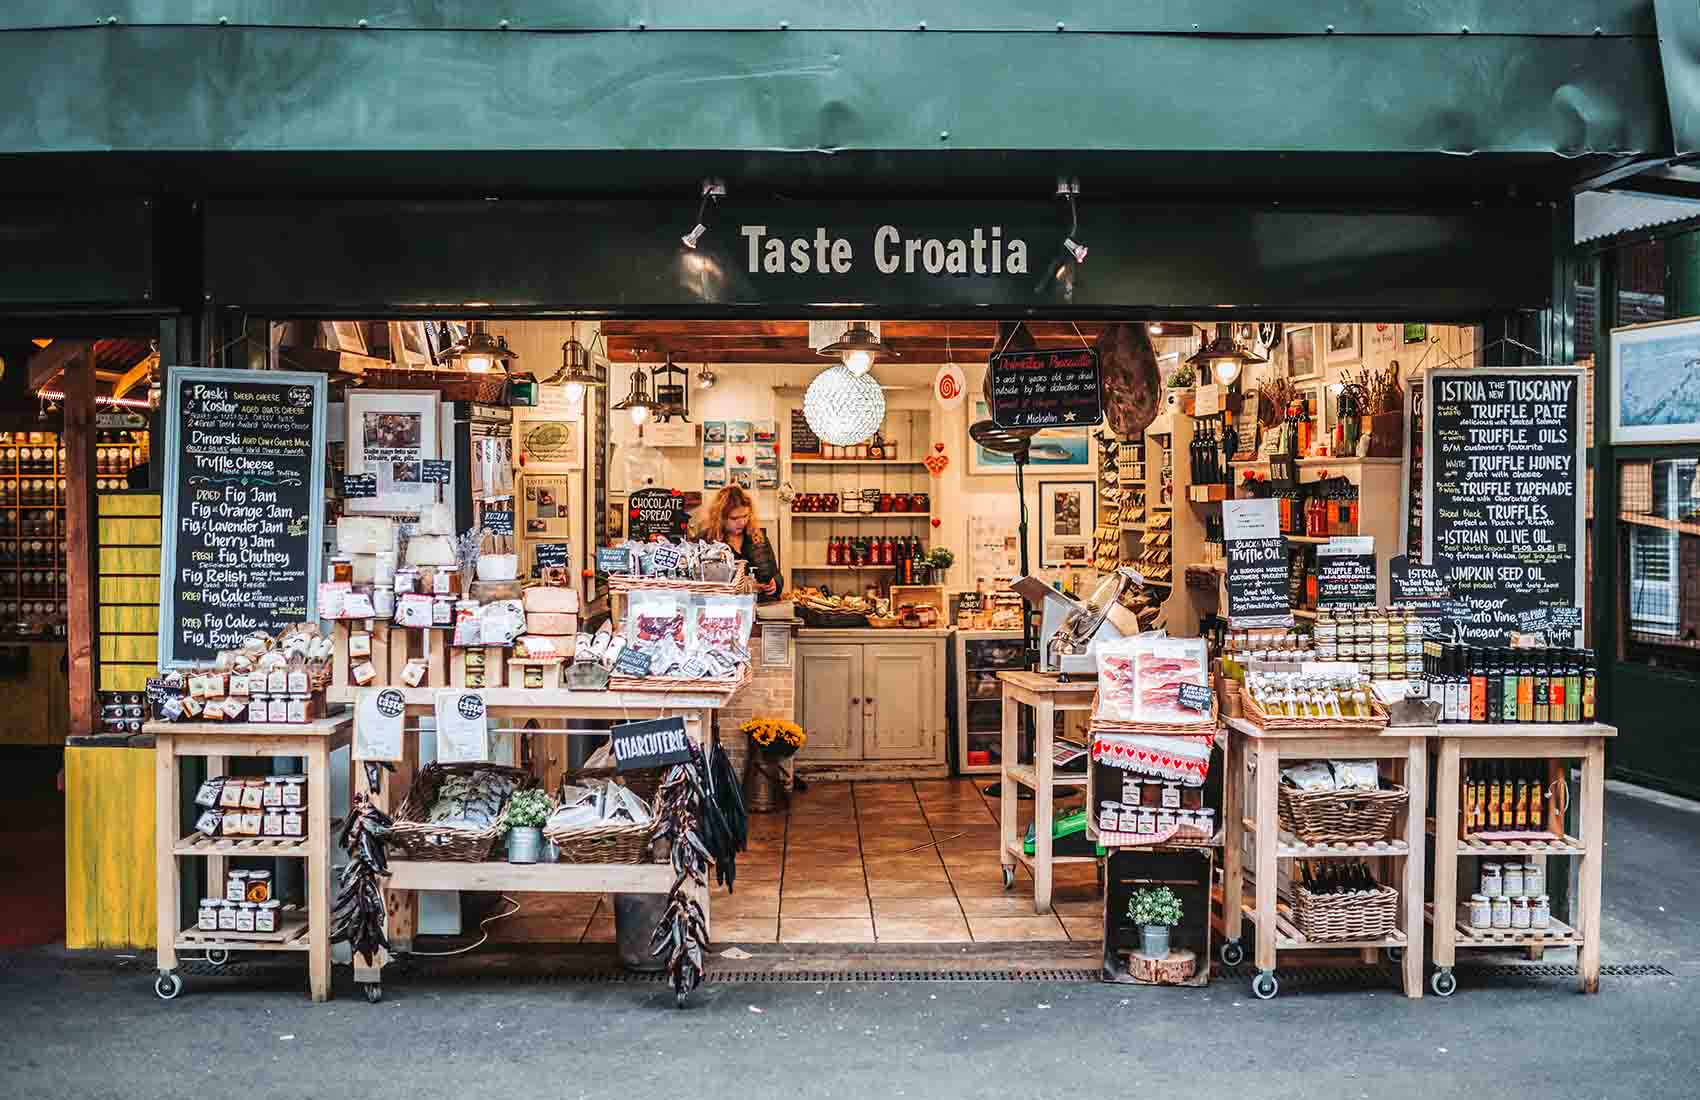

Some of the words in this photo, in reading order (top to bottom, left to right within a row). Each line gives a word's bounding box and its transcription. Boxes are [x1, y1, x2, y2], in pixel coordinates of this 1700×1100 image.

[741, 225, 852, 273] Taste
[874, 224, 1027, 273] Croatia
[1002, 373, 1017, 384] and
[1028, 374, 1048, 385] years
[1487, 381, 1505, 390] THE
[193, 385, 228, 400] Paski
[1024, 384, 1033, 396] by
[1441, 380, 1487, 402] ISTRIA
[1507, 379, 1573, 402] TUSCANY
[1488, 390, 1504, 400] NEW
[1470, 404, 1528, 419] TRUFFLE
[1533, 404, 1568, 419] PATE
[1459, 418, 1494, 426] delicious
[1535, 418, 1562, 427] Salmon
[192, 430, 241, 445] Dinarski
[1468, 428, 1528, 444] TRUFFLE
[1538, 428, 1568, 444] OILS
[194, 455, 234, 472] Truffle
[235, 456, 275, 470] Cheese
[1468, 455, 1525, 471] TRUFFLE
[1528, 455, 1571, 471] HONEY
[1465, 470, 1489, 481] great
[1512, 471, 1544, 479] cheese
[196, 489, 220, 501] DRIED
[225, 486, 246, 505] Fig
[250, 487, 277, 503] Jam
[1459, 481, 1512, 496] TRUFFLE
[1514, 481, 1573, 497] TAPENADE
[631, 496, 683, 510] CHOCOLATE
[191, 502, 211, 518] Fig
[219, 503, 262, 521] Orange
[266, 504, 293, 519] Jam
[639, 509, 672, 521] SPREAD
[1462, 509, 1482, 518] black
[1485, 504, 1549, 520] TRUFFLES
[182, 518, 201, 535] Fig
[208, 520, 257, 533] Lavender
[258, 520, 283, 534] Jam
[1490, 519, 1516, 527] Pasta
[204, 532, 248, 549] Cherry
[249, 535, 275, 548] Jam
[1234, 540, 1257, 549] BLACK
[1261, 538, 1282, 548] WHITE
[1444, 529, 1489, 545] ISTRIAN
[1495, 528, 1530, 545] OLIVE
[1532, 529, 1552, 545] OIL
[217, 548, 238, 565] Fig
[240, 549, 290, 568] Chutney
[1228, 547, 1264, 565] Truffle
[1264, 547, 1281, 560] Oil
[182, 568, 203, 586] Fig
[206, 569, 247, 583] Relish
[1322, 567, 1353, 575] TRUFFLE
[1408, 568, 1439, 579] ISTRIA
[1497, 567, 1524, 581] SEED
[1527, 567, 1546, 581] OIL
[182, 591, 201, 601] DRIED
[202, 589, 220, 606] Fig
[220, 588, 251, 602] Cake
[204, 613, 223, 631] Fig
[224, 613, 257, 629] Cake
[1493, 610, 1518, 624] Vine
[183, 631, 205, 646] Fig
[1459, 624, 1503, 640] Vinegar
[378, 698, 405, 712] taste
[459, 701, 483, 714] taste
[613, 728, 689, 761] CHARCUTERIE
